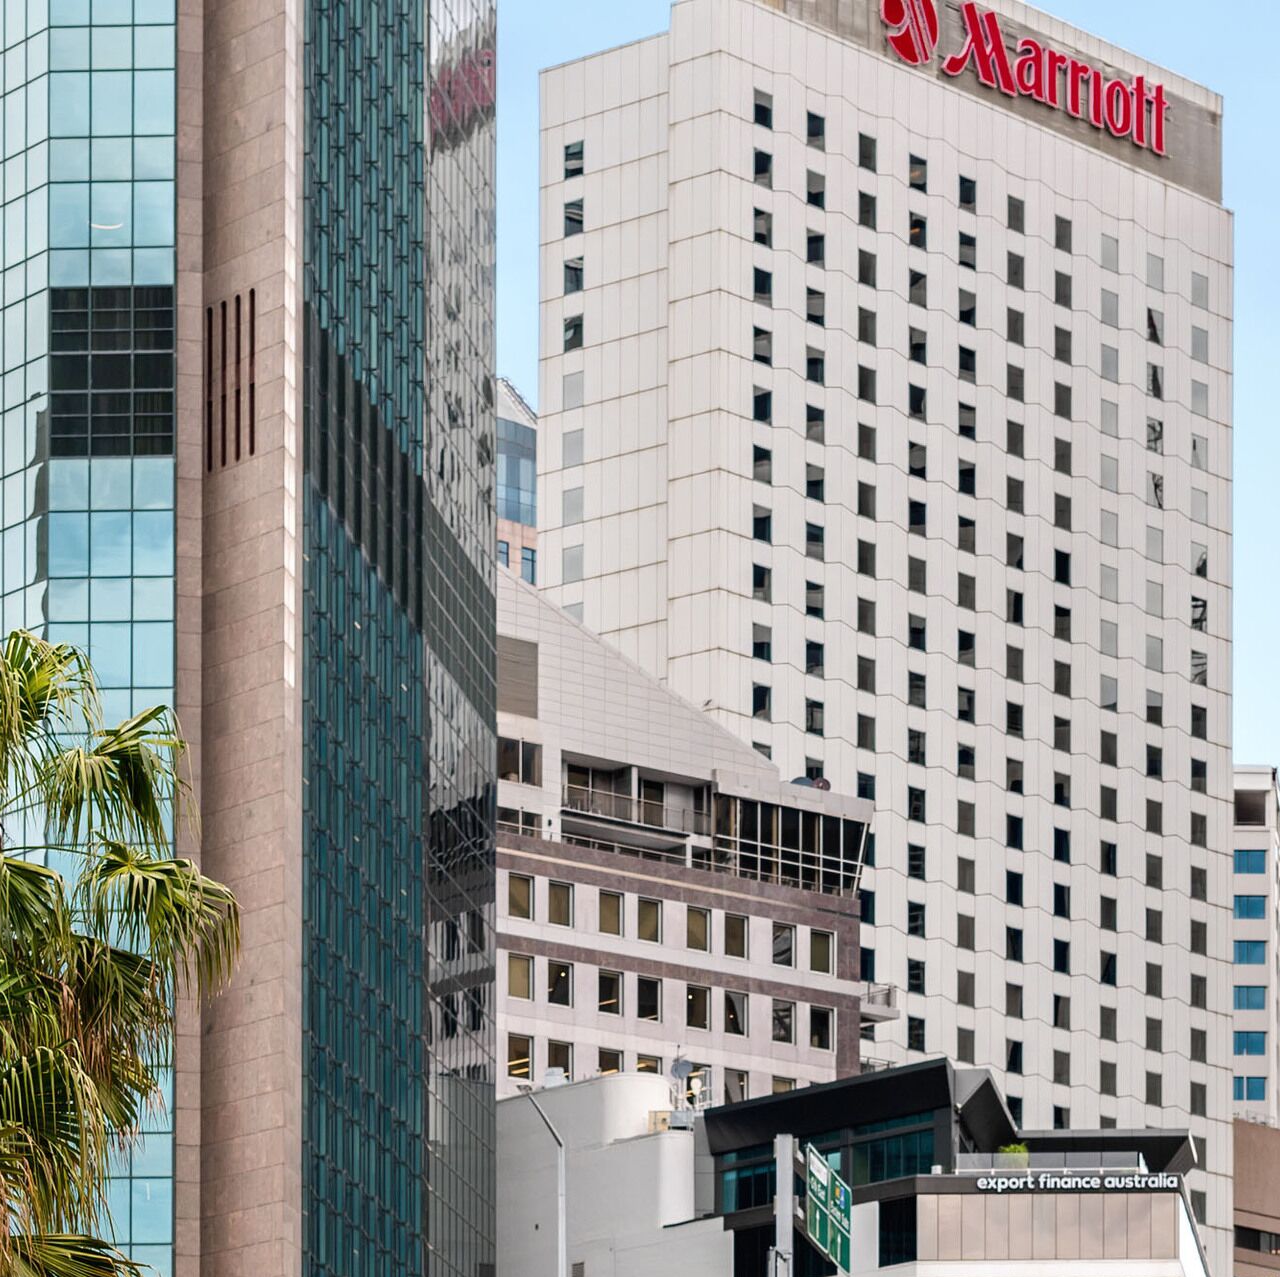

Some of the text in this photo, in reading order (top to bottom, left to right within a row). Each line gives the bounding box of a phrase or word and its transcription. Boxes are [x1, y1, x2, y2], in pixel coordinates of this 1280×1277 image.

[942, 2, 1170, 156] Marriott
[976, 1173, 1178, 1192] export finance australia
